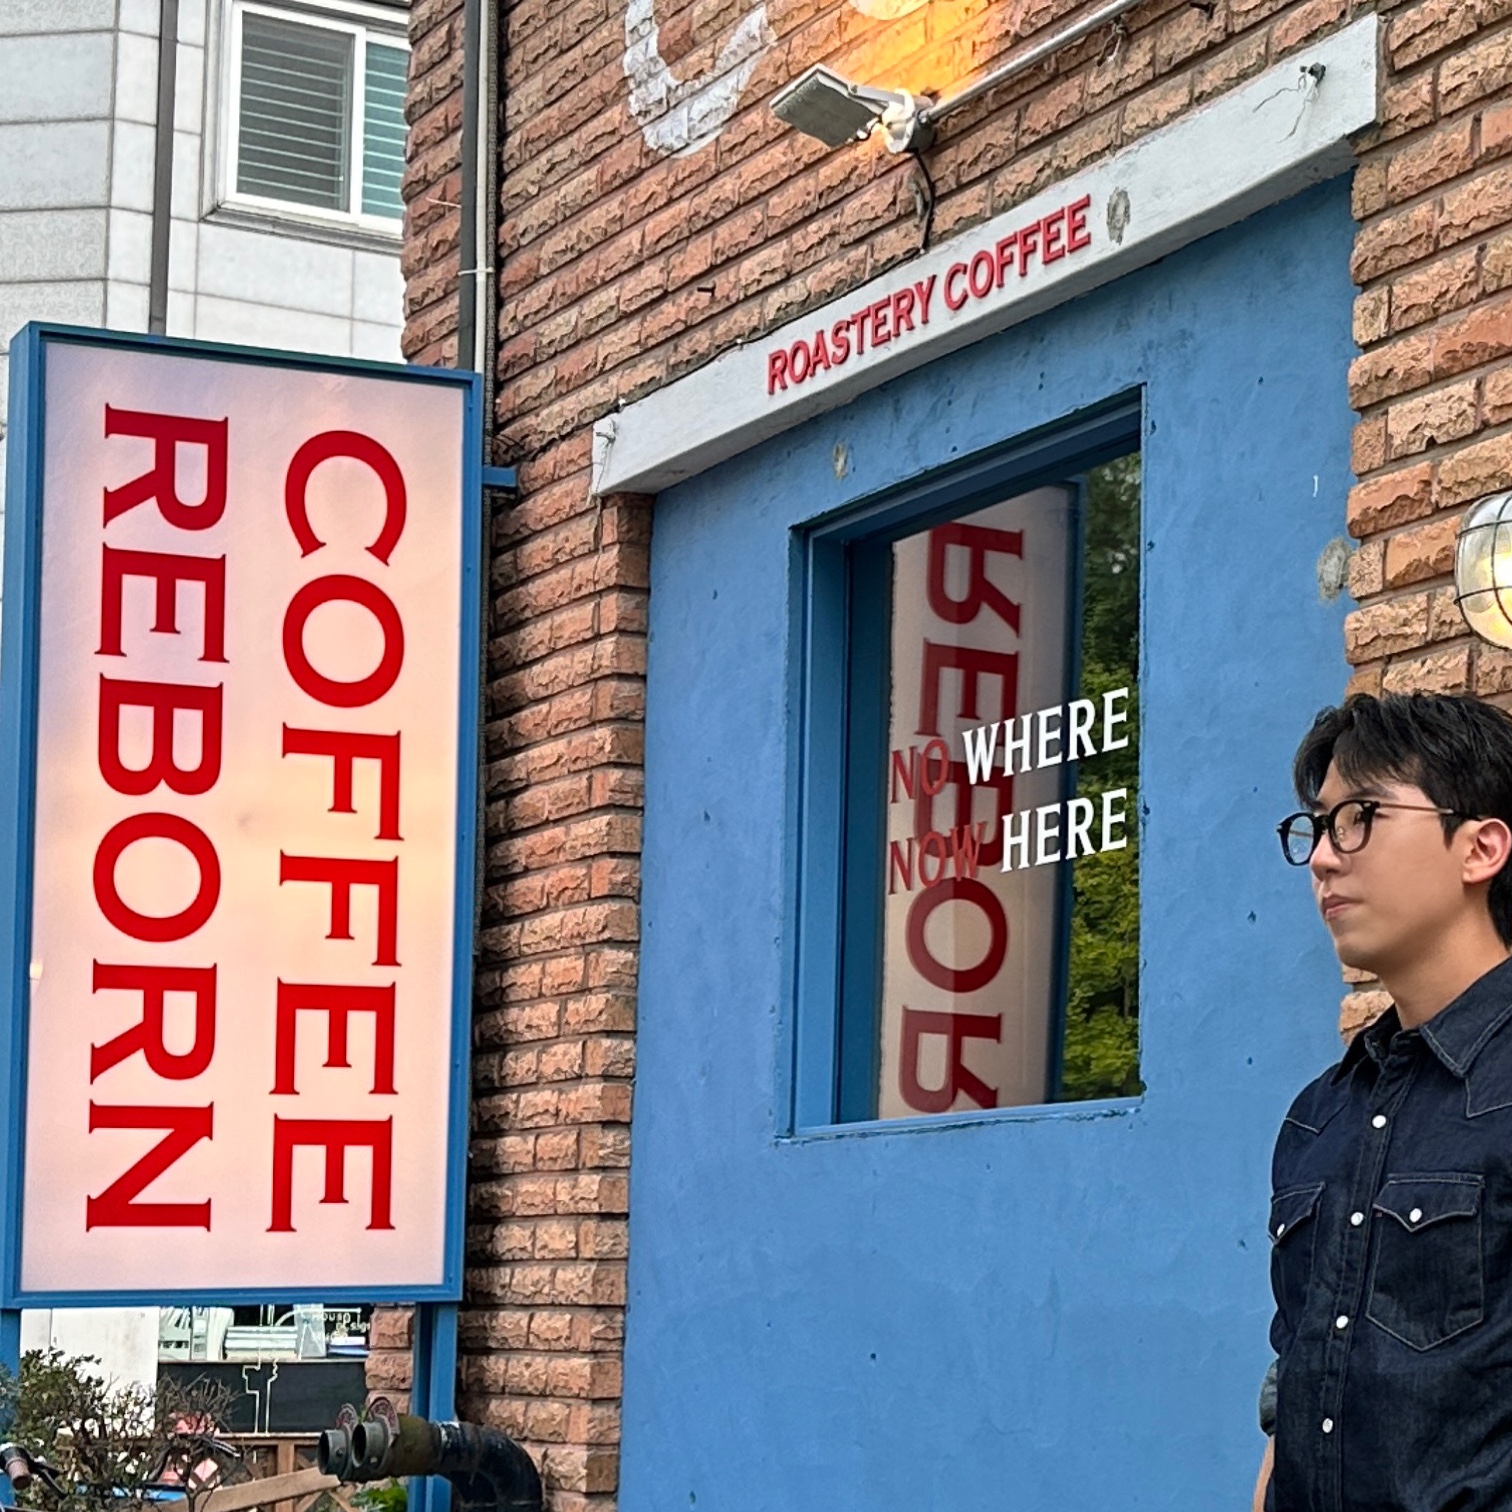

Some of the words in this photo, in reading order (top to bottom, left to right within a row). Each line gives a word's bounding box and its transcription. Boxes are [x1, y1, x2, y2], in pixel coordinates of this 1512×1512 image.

[767, 274, 937, 396] ROASTERY
[943, 193, 1092, 311] COFFEE
[86, 402, 230, 1233] REBORN
[265, 430, 408, 1232] COFFEE
[888, 821, 987, 896] NOW
[1000, 787, 1128, 873] HERE
[890, 737, 950, 804] NO
[962, 687, 1129, 785] WHERE
